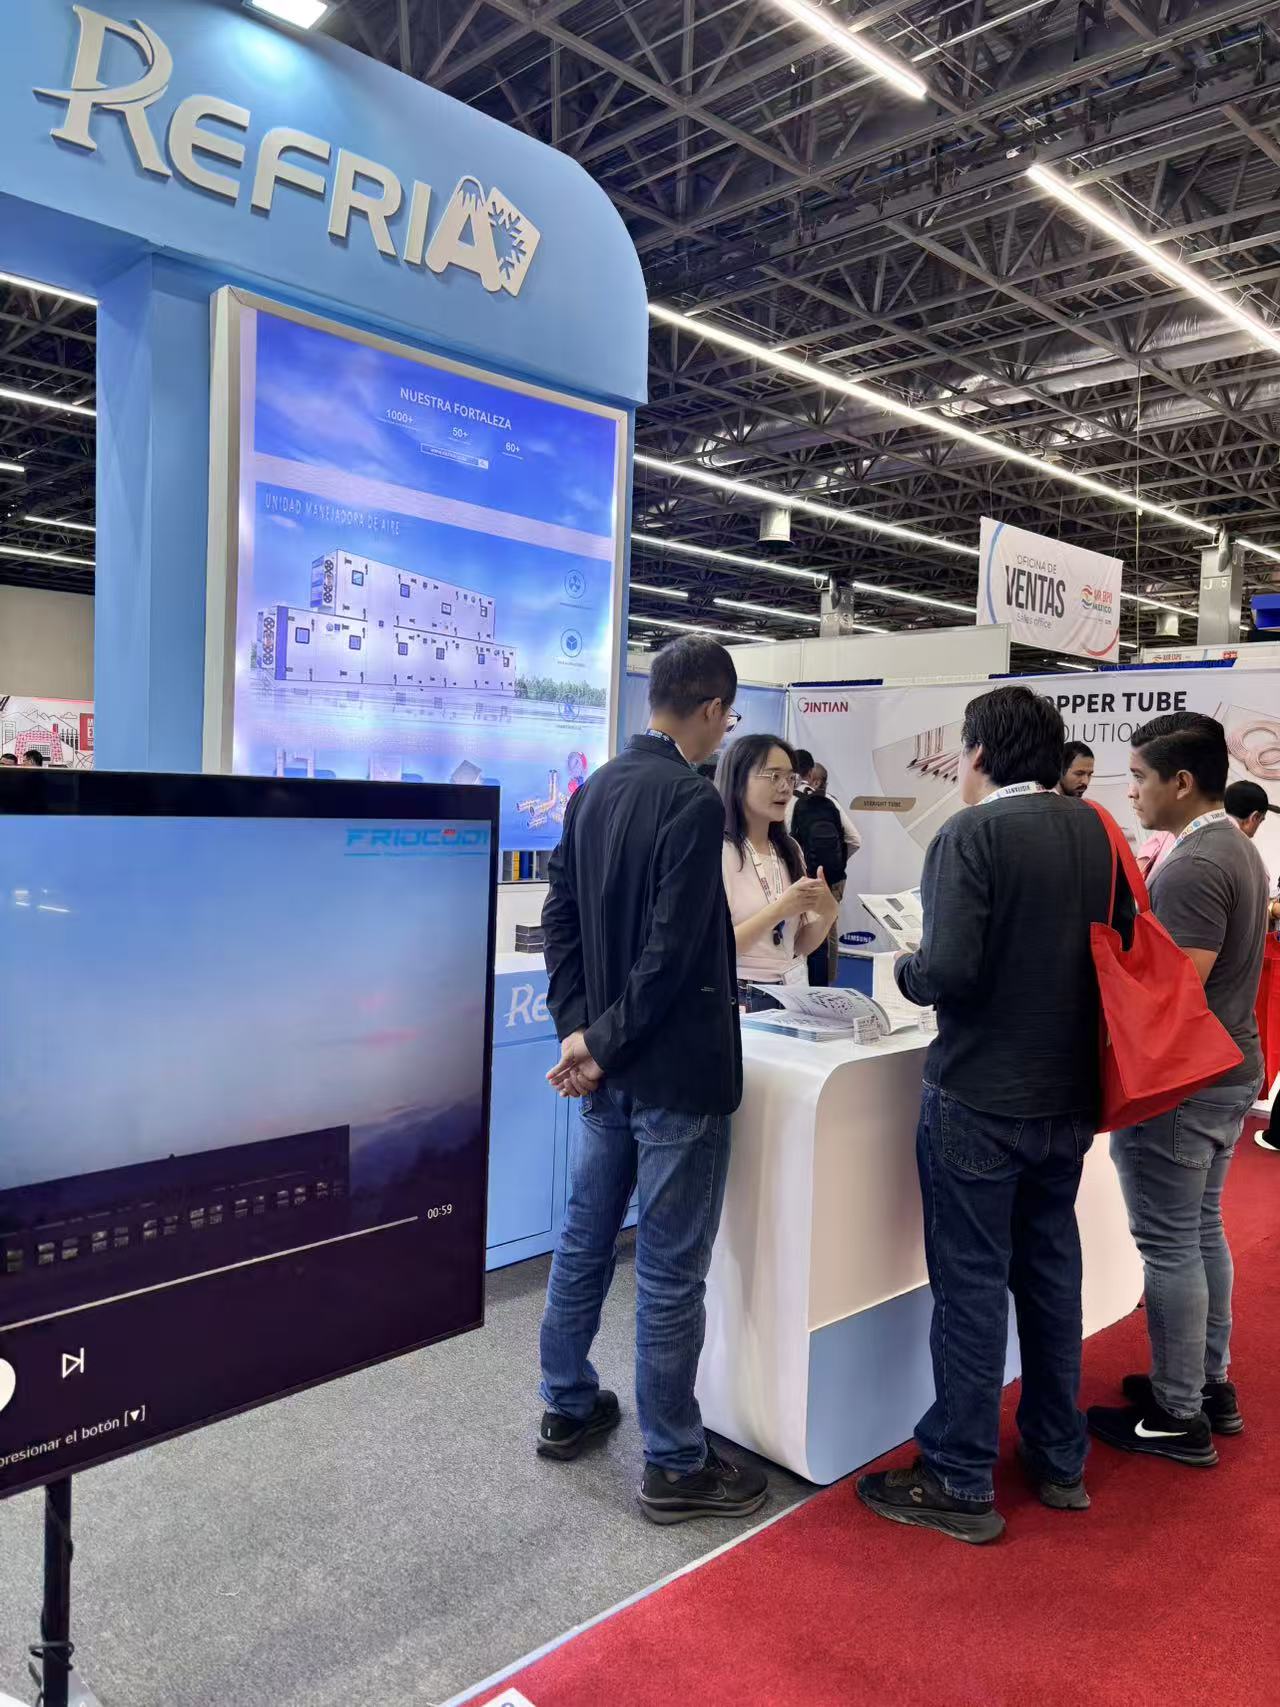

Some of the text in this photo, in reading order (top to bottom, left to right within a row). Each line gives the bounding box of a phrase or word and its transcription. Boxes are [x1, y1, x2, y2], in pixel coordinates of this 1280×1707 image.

[386, 408, 414, 424] 1000+
[400, 386, 512, 431] NUESTRA FORTALEZA
[452, 427, 468, 438] 50+
[1017, 554, 1046, 571] OFICINA
[1005, 564, 1066, 619] VENTAS
[1046, 691, 1187, 713] PPER TUBE
[427, 1203, 453, 1219] 00:59
[65, 1430, 77, 1445] el
[81, 1418, 120, 1440] botón
